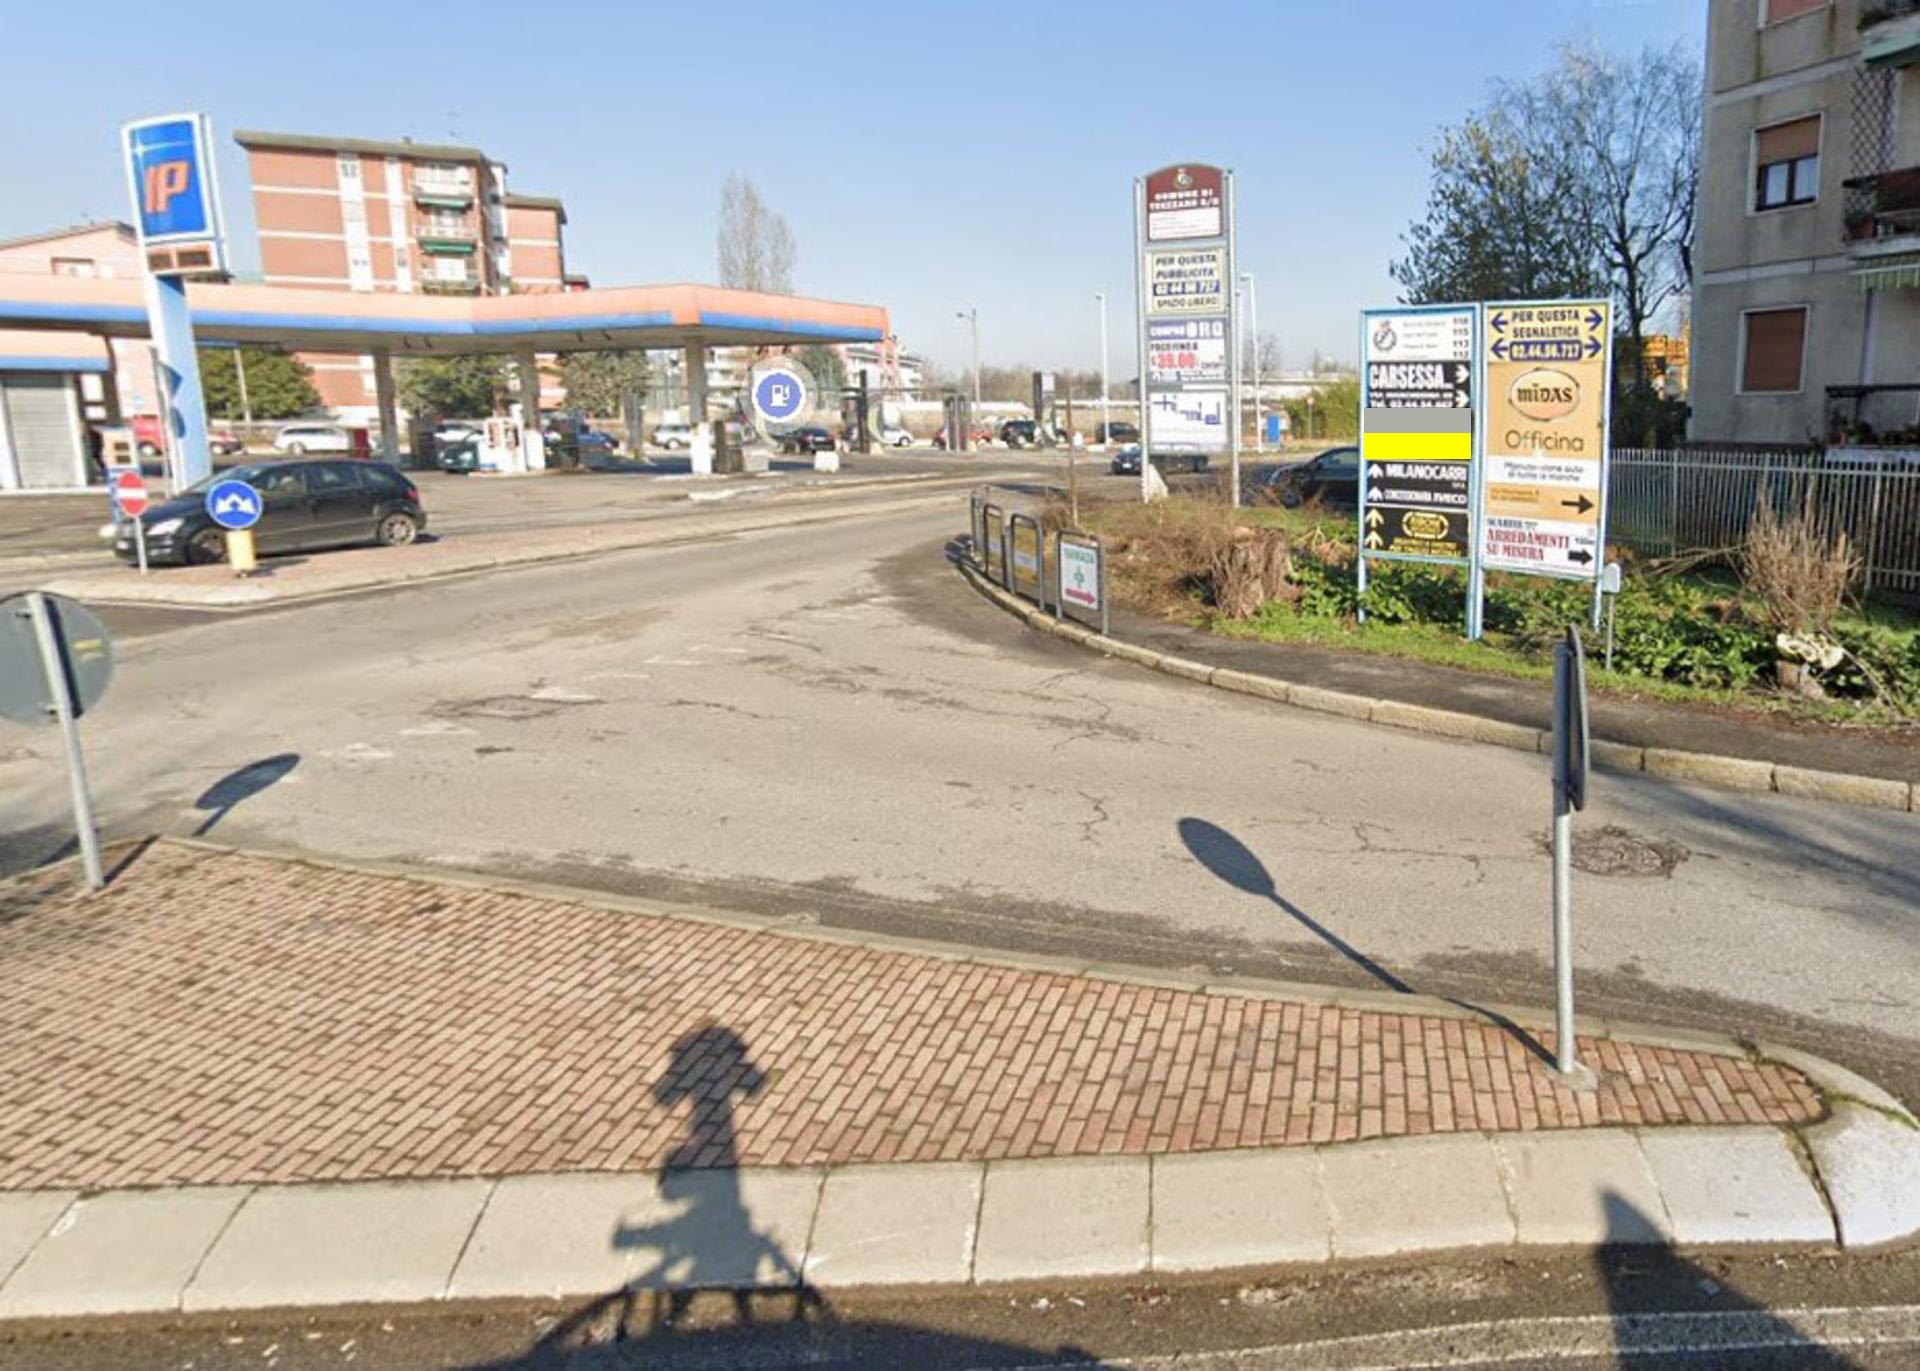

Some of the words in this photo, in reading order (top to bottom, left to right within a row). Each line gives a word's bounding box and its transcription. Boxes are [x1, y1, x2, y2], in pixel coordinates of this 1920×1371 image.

[144, 160, 190, 214] IP
[1156, 257, 1175, 266] PER
[1178, 254, 1217, 266] QUESTA
[1511, 311, 1533, 322] PER
[1537, 309, 1579, 323] QUESTA
[1512, 326, 1579, 339] SEGNALETICA
[1370, 363, 1445, 390] CARSESSA
[1505, 429, 1585, 452] Officina
[1385, 463, 1467, 482] MILANOCARRI
[1487, 529, 1570, 549] ARREDAMENTI
[1487, 543, 1497, 555] SU
[1502, 544, 1545, 561] MISURA
